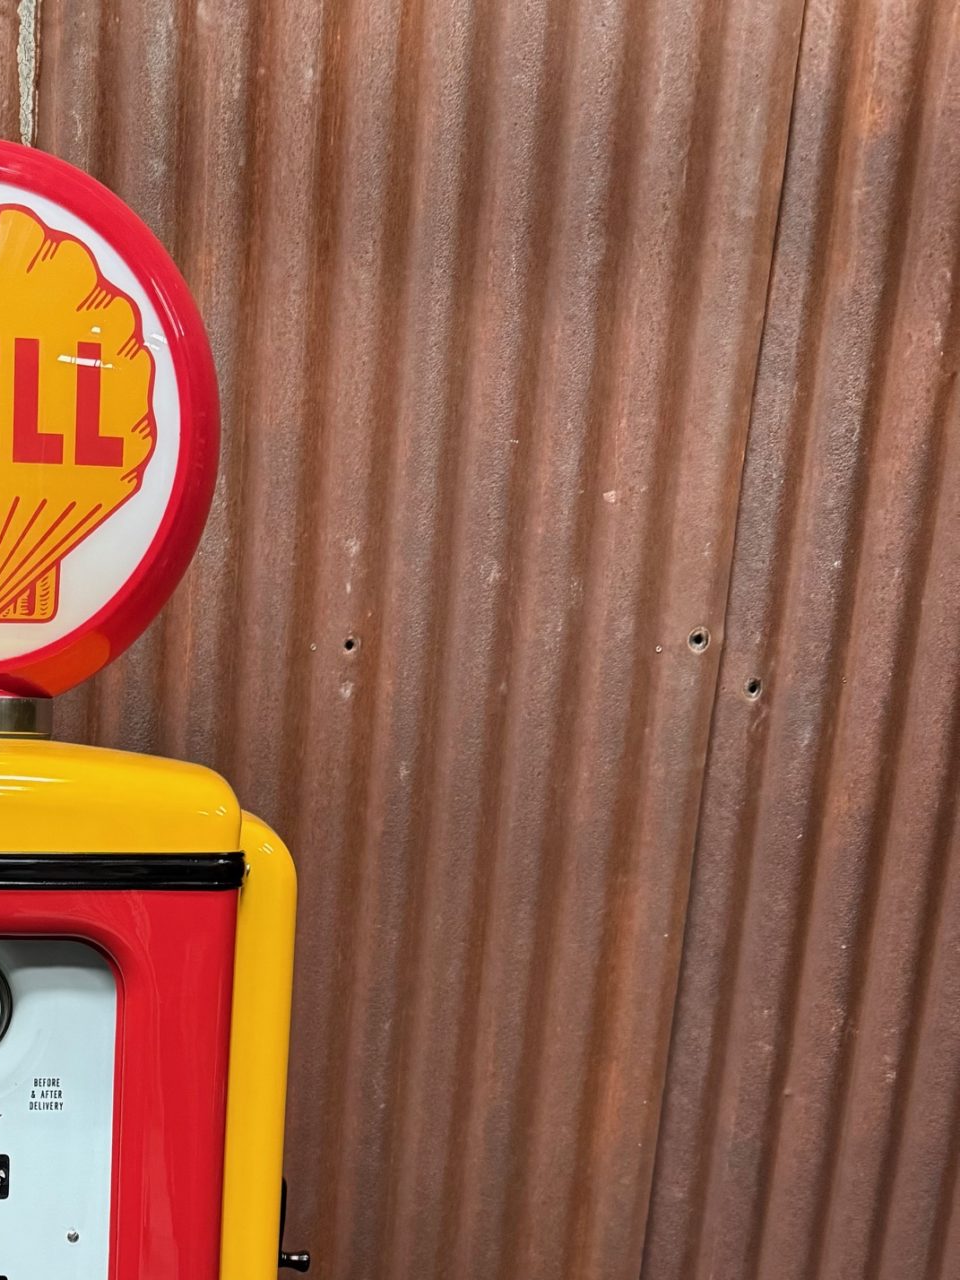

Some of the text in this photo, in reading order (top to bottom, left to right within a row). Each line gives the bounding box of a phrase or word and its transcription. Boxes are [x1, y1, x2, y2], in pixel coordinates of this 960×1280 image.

[33, 1078, 61, 1087] BEFORE
[30, 1089, 63, 1099] & AFTER
[29, 1101, 64, 1111] DELIVERY
